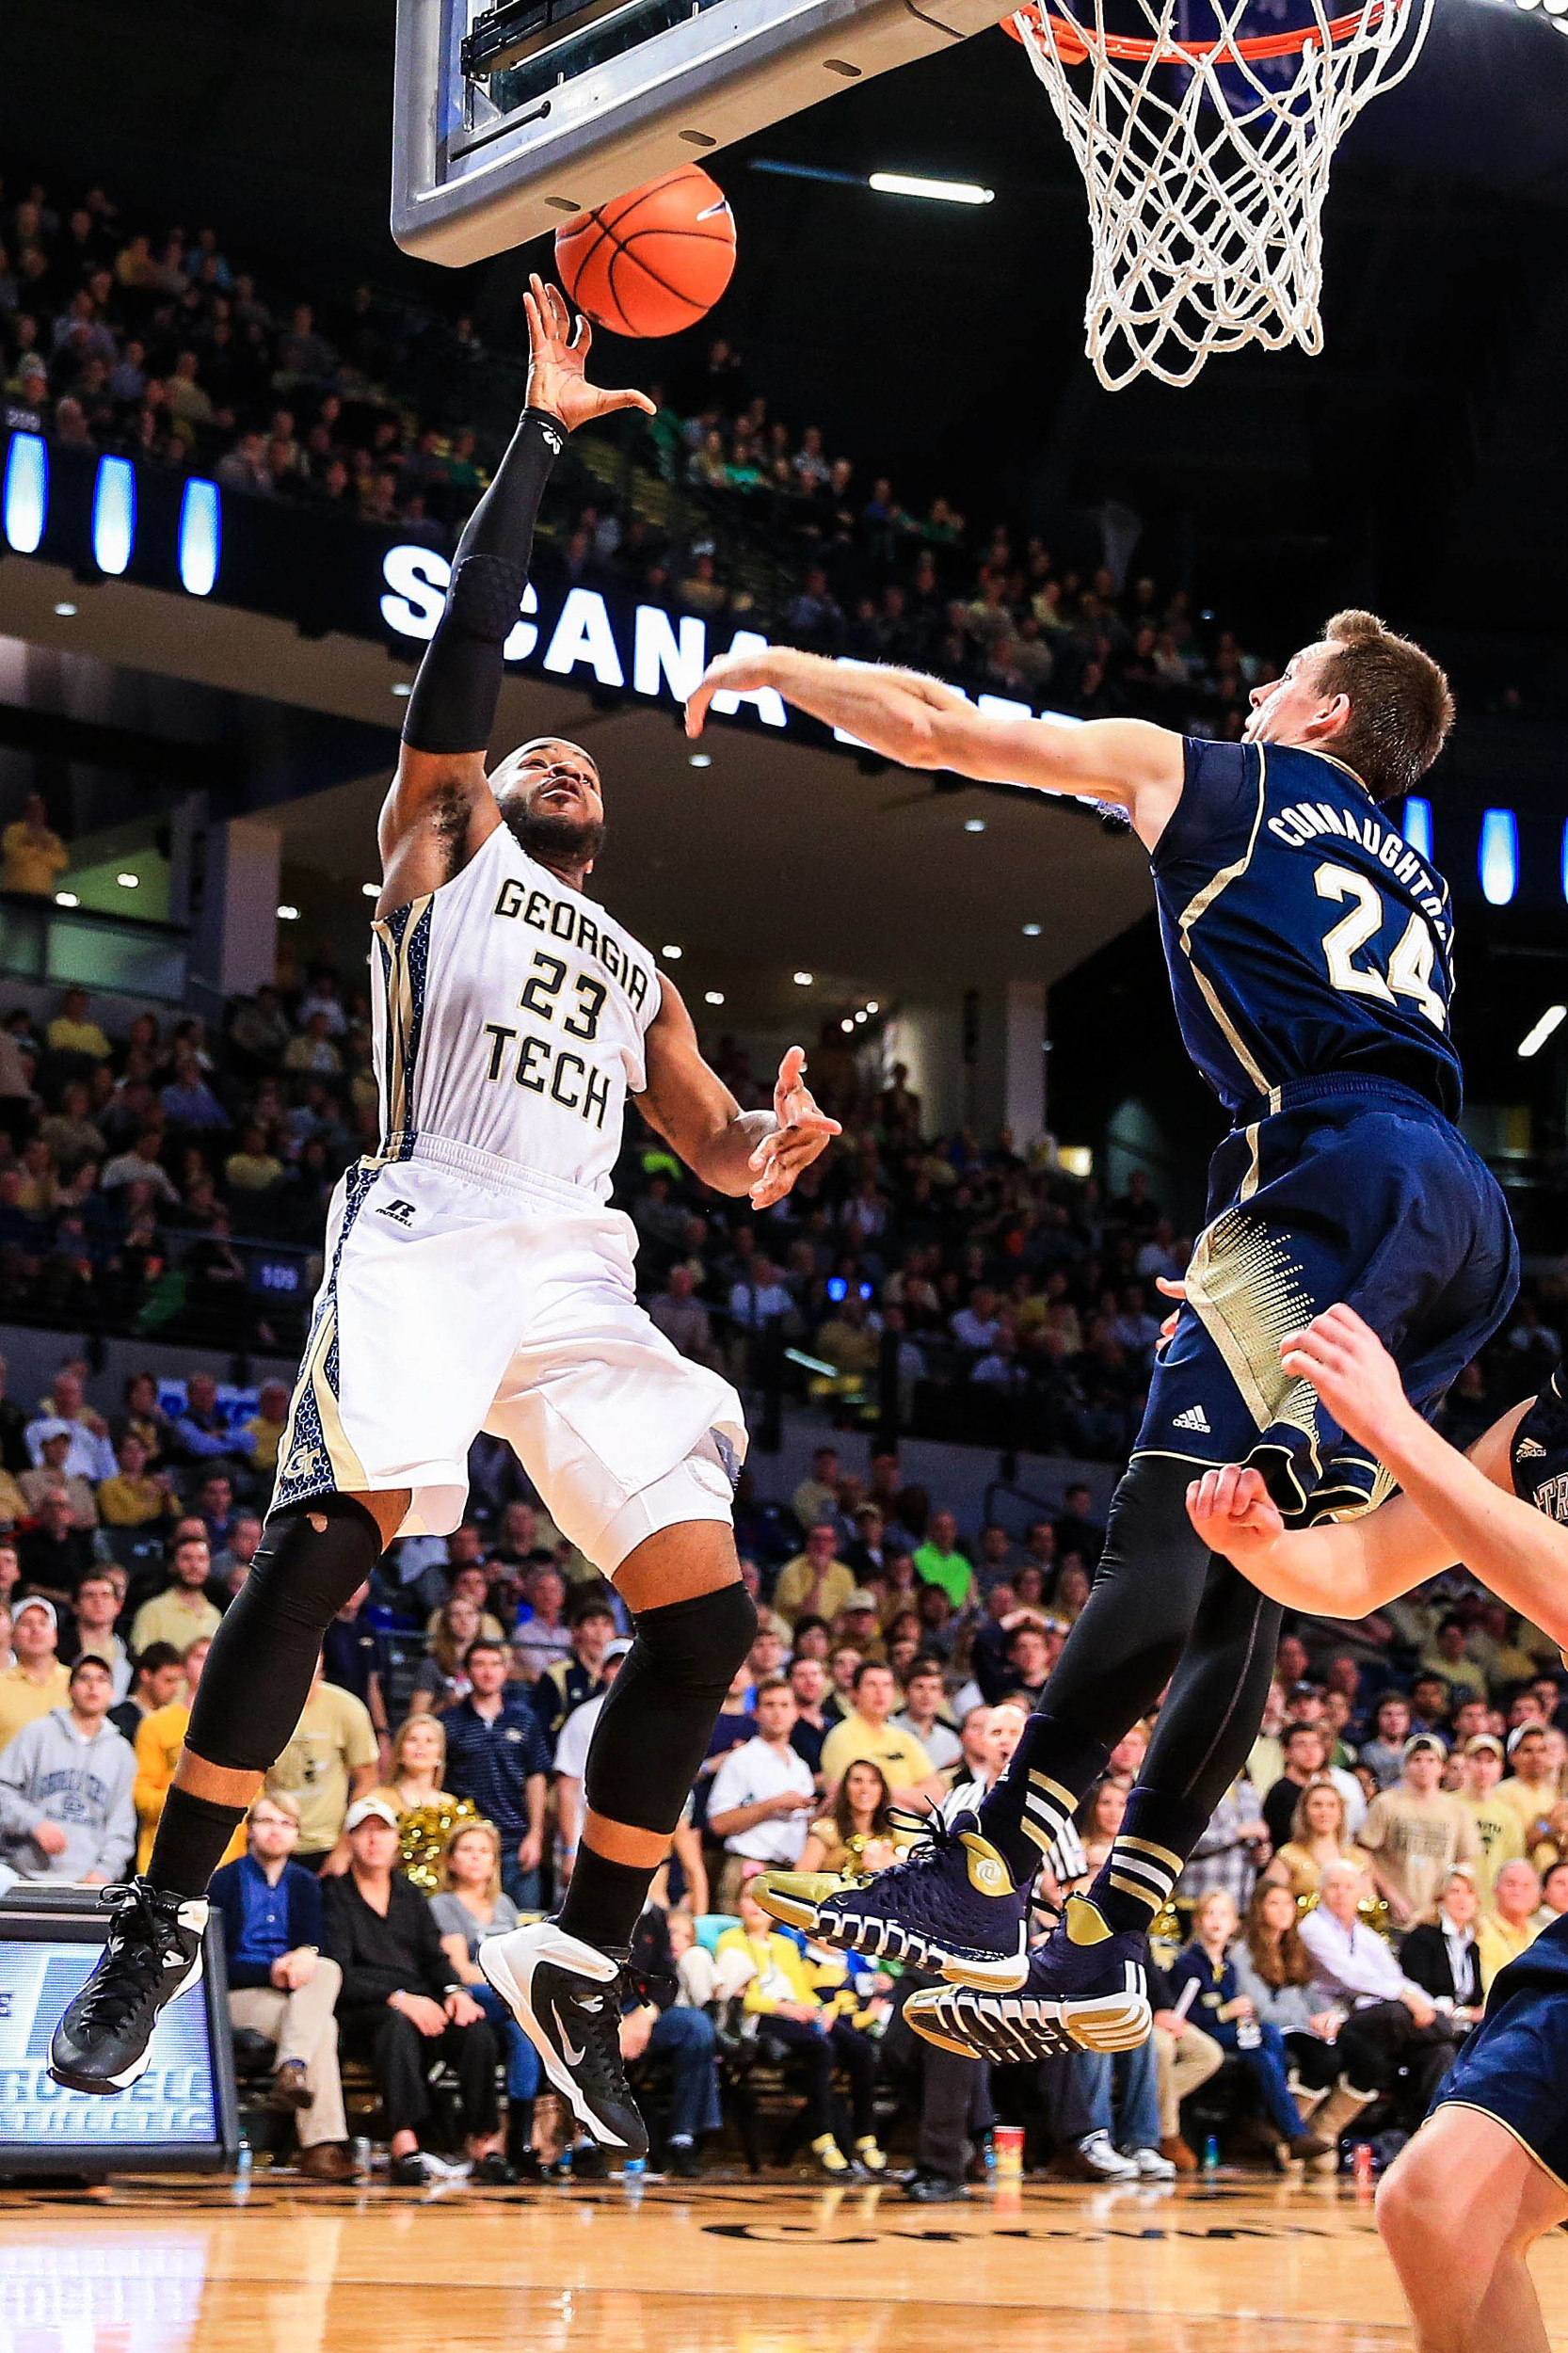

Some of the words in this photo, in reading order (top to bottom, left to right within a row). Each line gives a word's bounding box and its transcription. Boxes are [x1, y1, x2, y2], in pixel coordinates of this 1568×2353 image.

[494, 877, 649, 1014] GEORGIA
[519, 948, 608, 1043] 23
[1313, 861, 1447, 1032] 24
[483, 1022, 613, 1132] TECH
[1172, 1418, 1212, 1433] adidas
[1516, 1449, 1547, 1464] adidas
